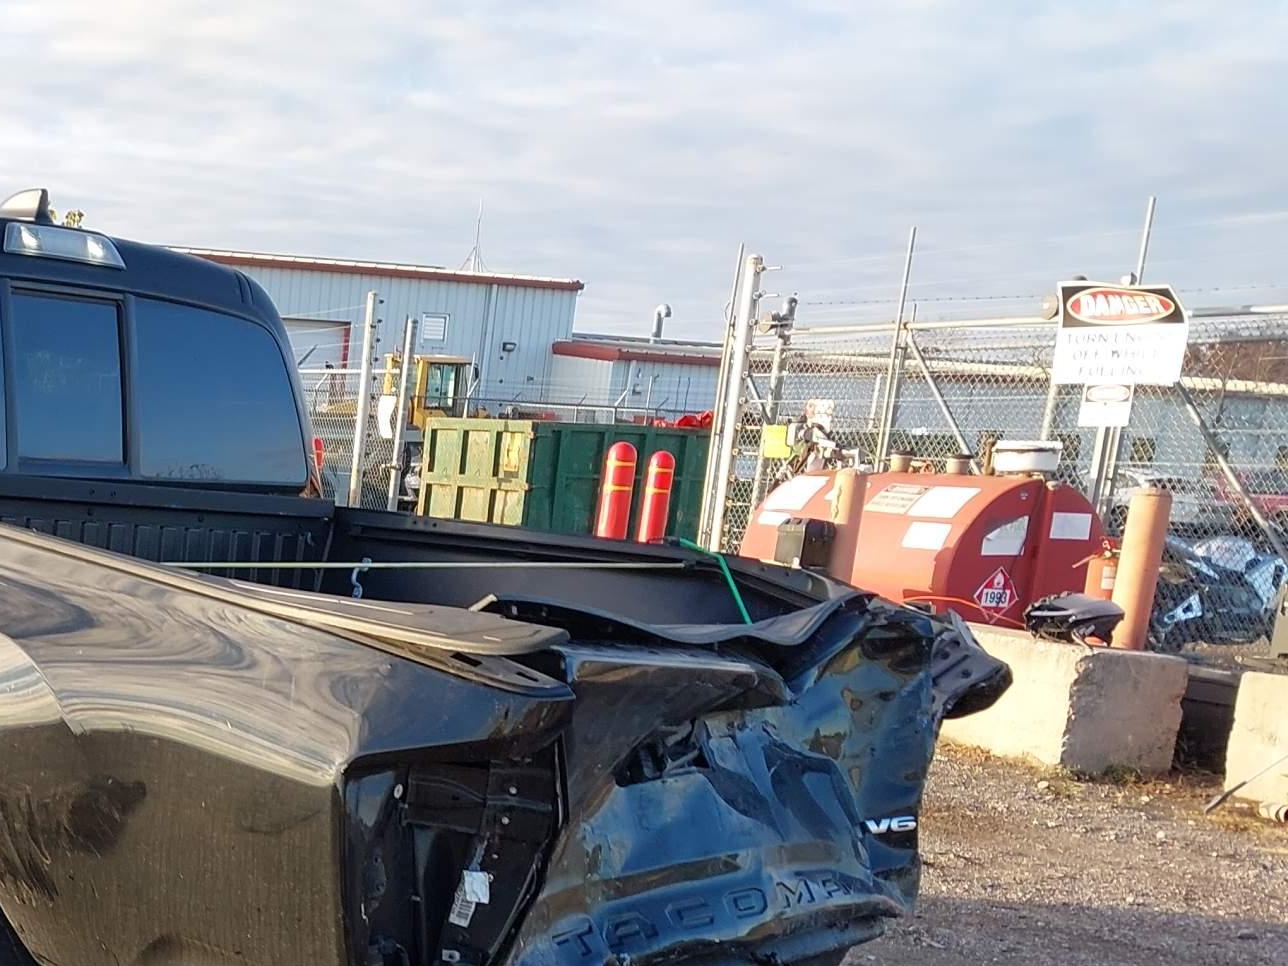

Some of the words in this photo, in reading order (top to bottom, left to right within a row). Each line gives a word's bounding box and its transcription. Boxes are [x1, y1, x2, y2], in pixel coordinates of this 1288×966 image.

[1079, 294, 1166, 317] DANGER
[983, 591, 1008, 605] 1993
[865, 816, 917, 834] V6
[551, 871, 852, 957] TACOMA
